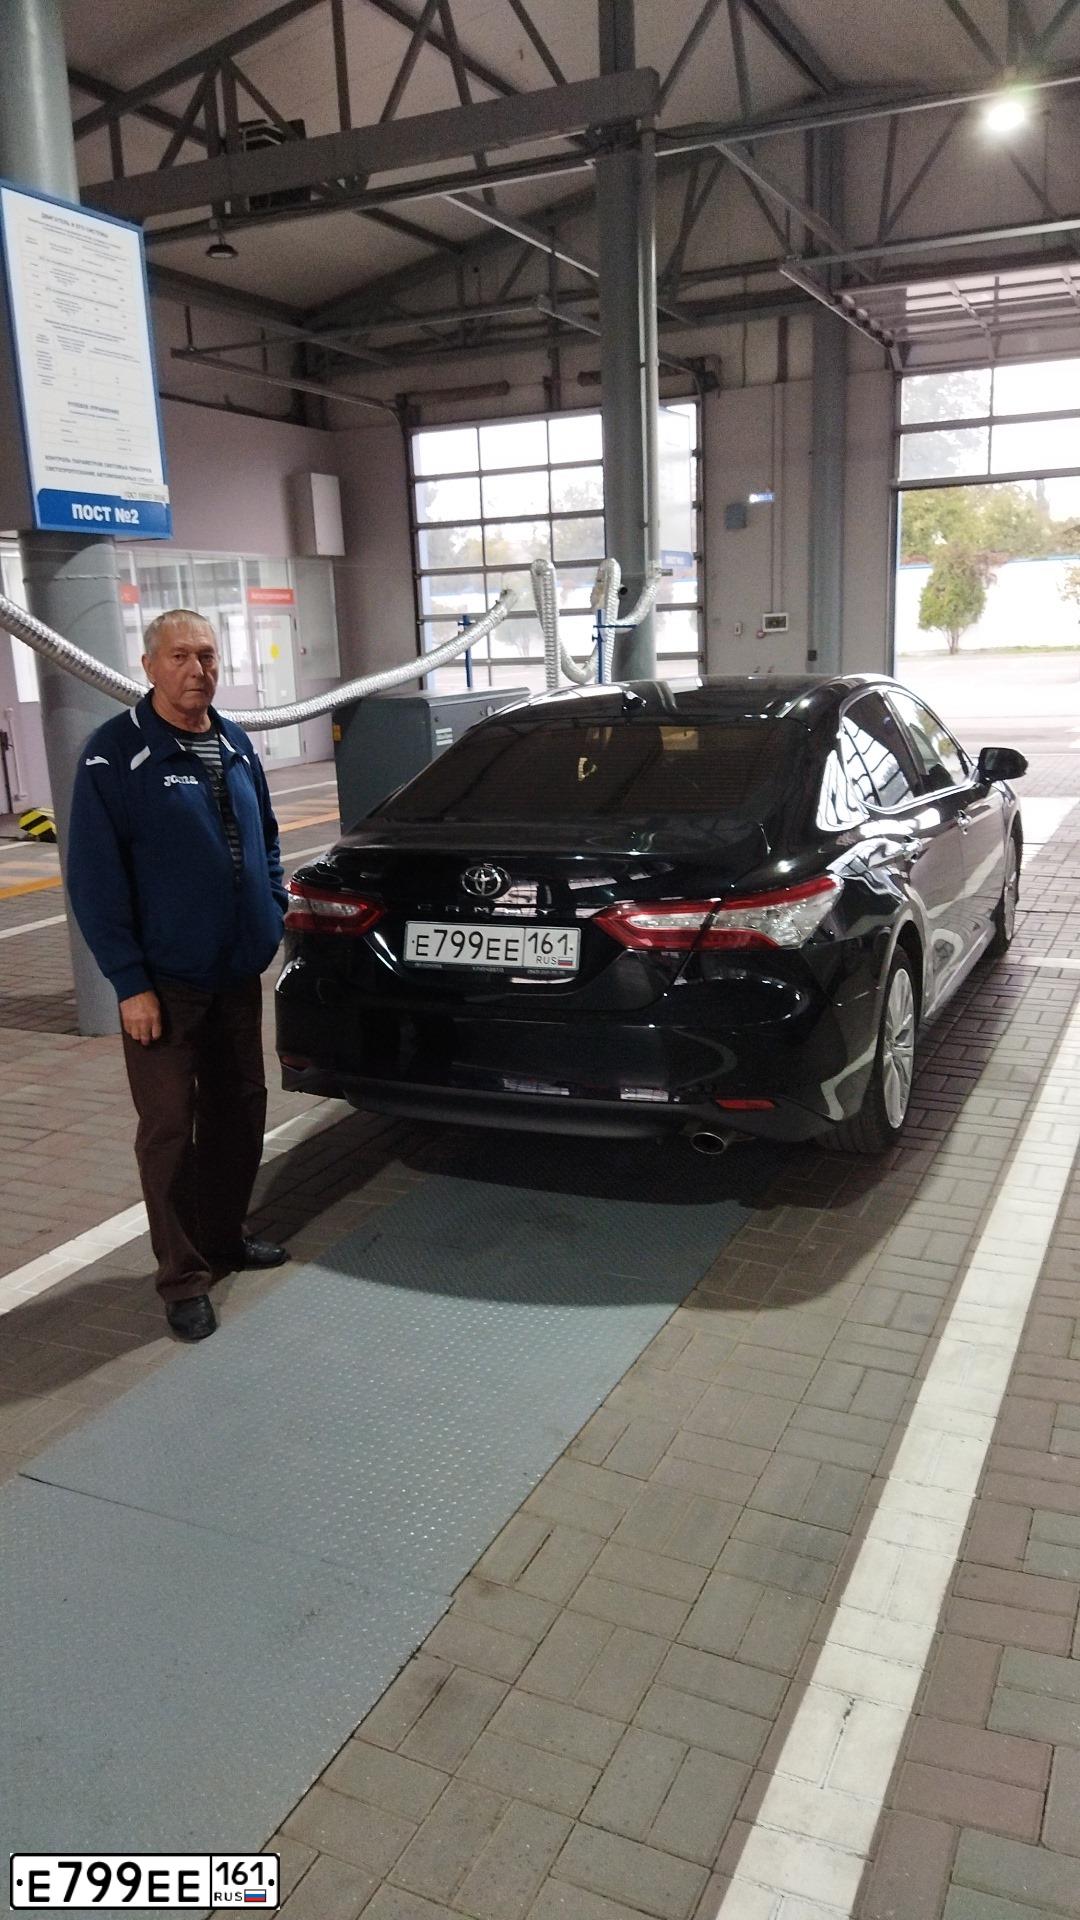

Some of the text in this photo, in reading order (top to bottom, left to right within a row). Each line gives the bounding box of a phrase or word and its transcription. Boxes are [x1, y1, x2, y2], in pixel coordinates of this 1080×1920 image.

[72, 503, 140, 525] ПОСТ №2
[528, 932, 569, 956] 161
[536, 956, 557, 965] RUS
